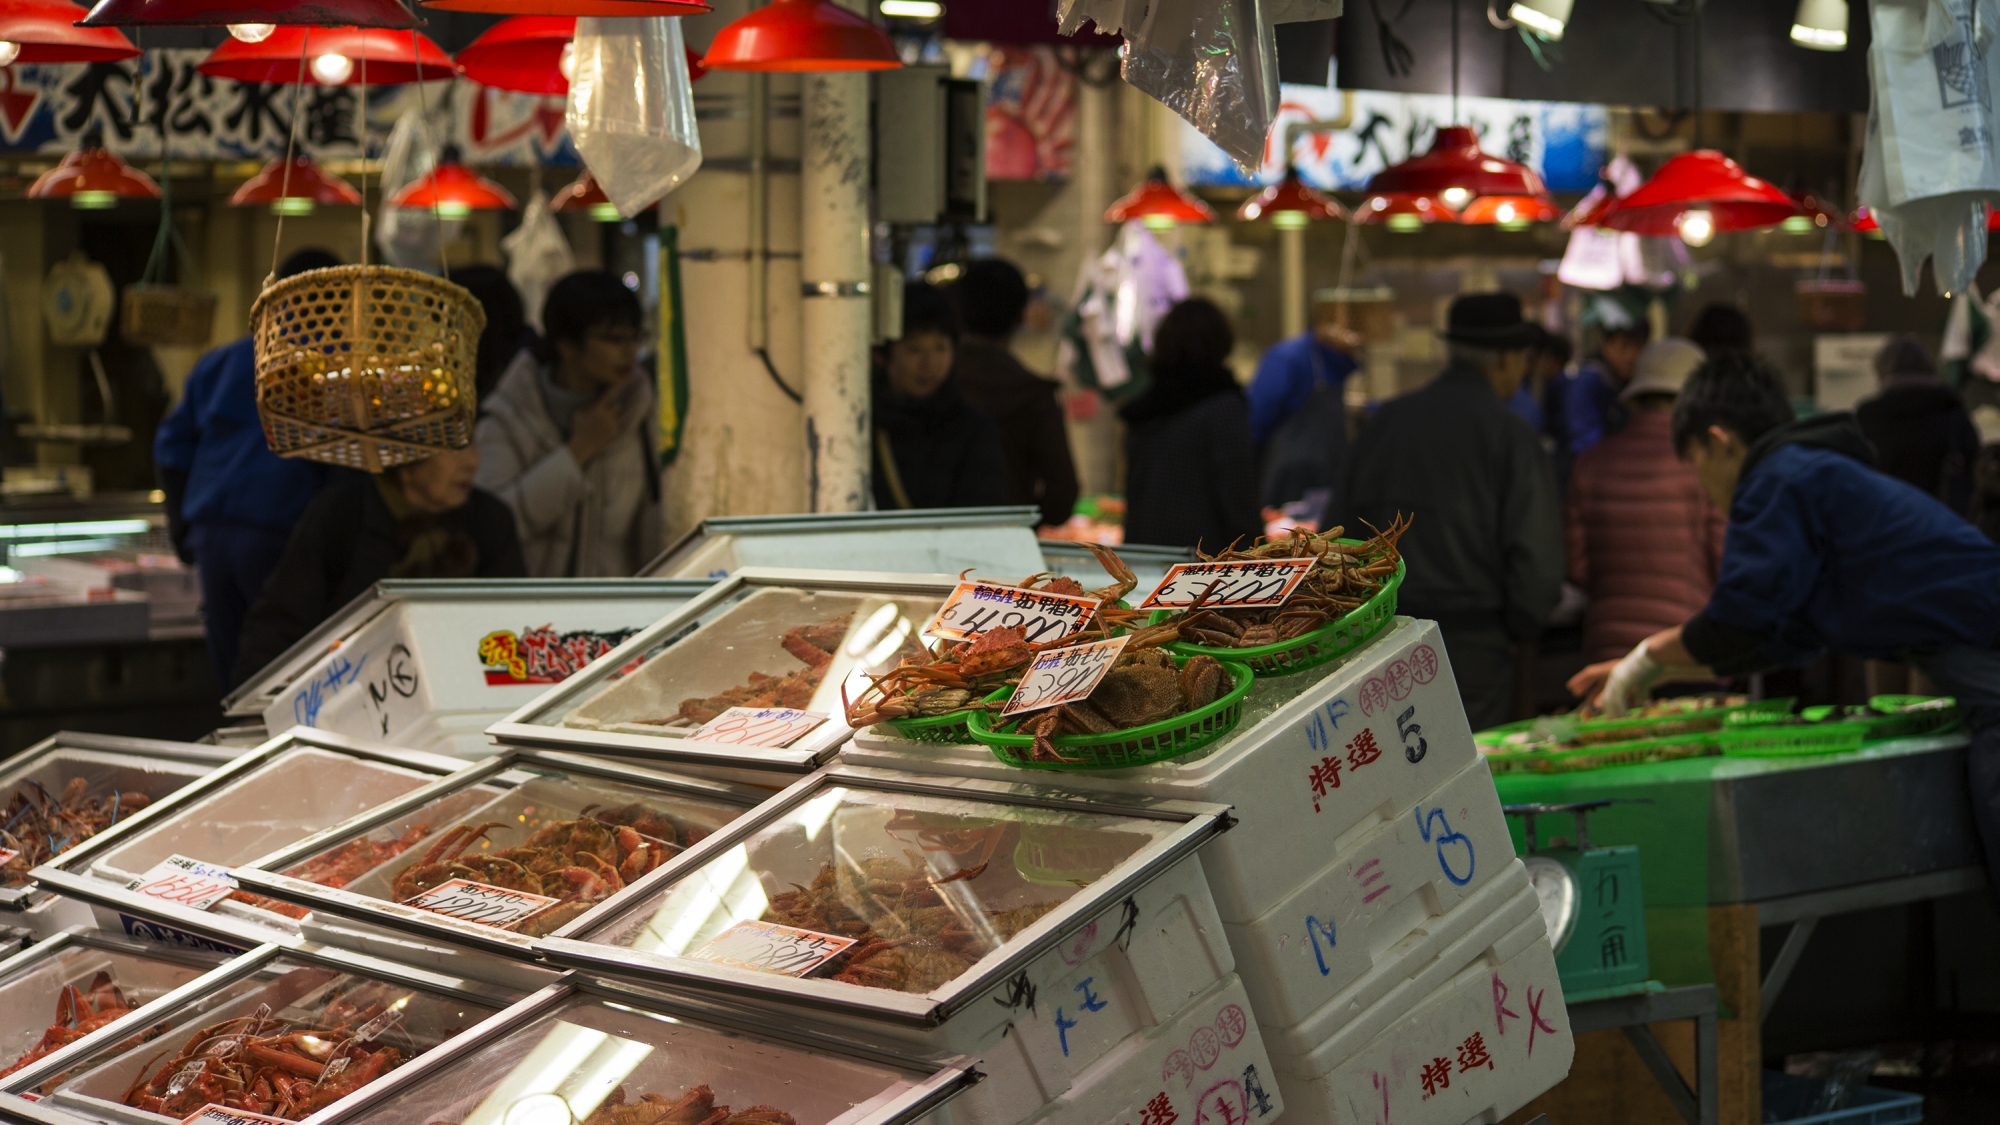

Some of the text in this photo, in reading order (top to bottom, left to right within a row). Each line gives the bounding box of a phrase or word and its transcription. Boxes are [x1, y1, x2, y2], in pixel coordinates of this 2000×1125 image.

[1308, 727, 1383, 797] 特選
[1396, 705, 1427, 764] 5
[1420, 1031, 1491, 1096] 特選
